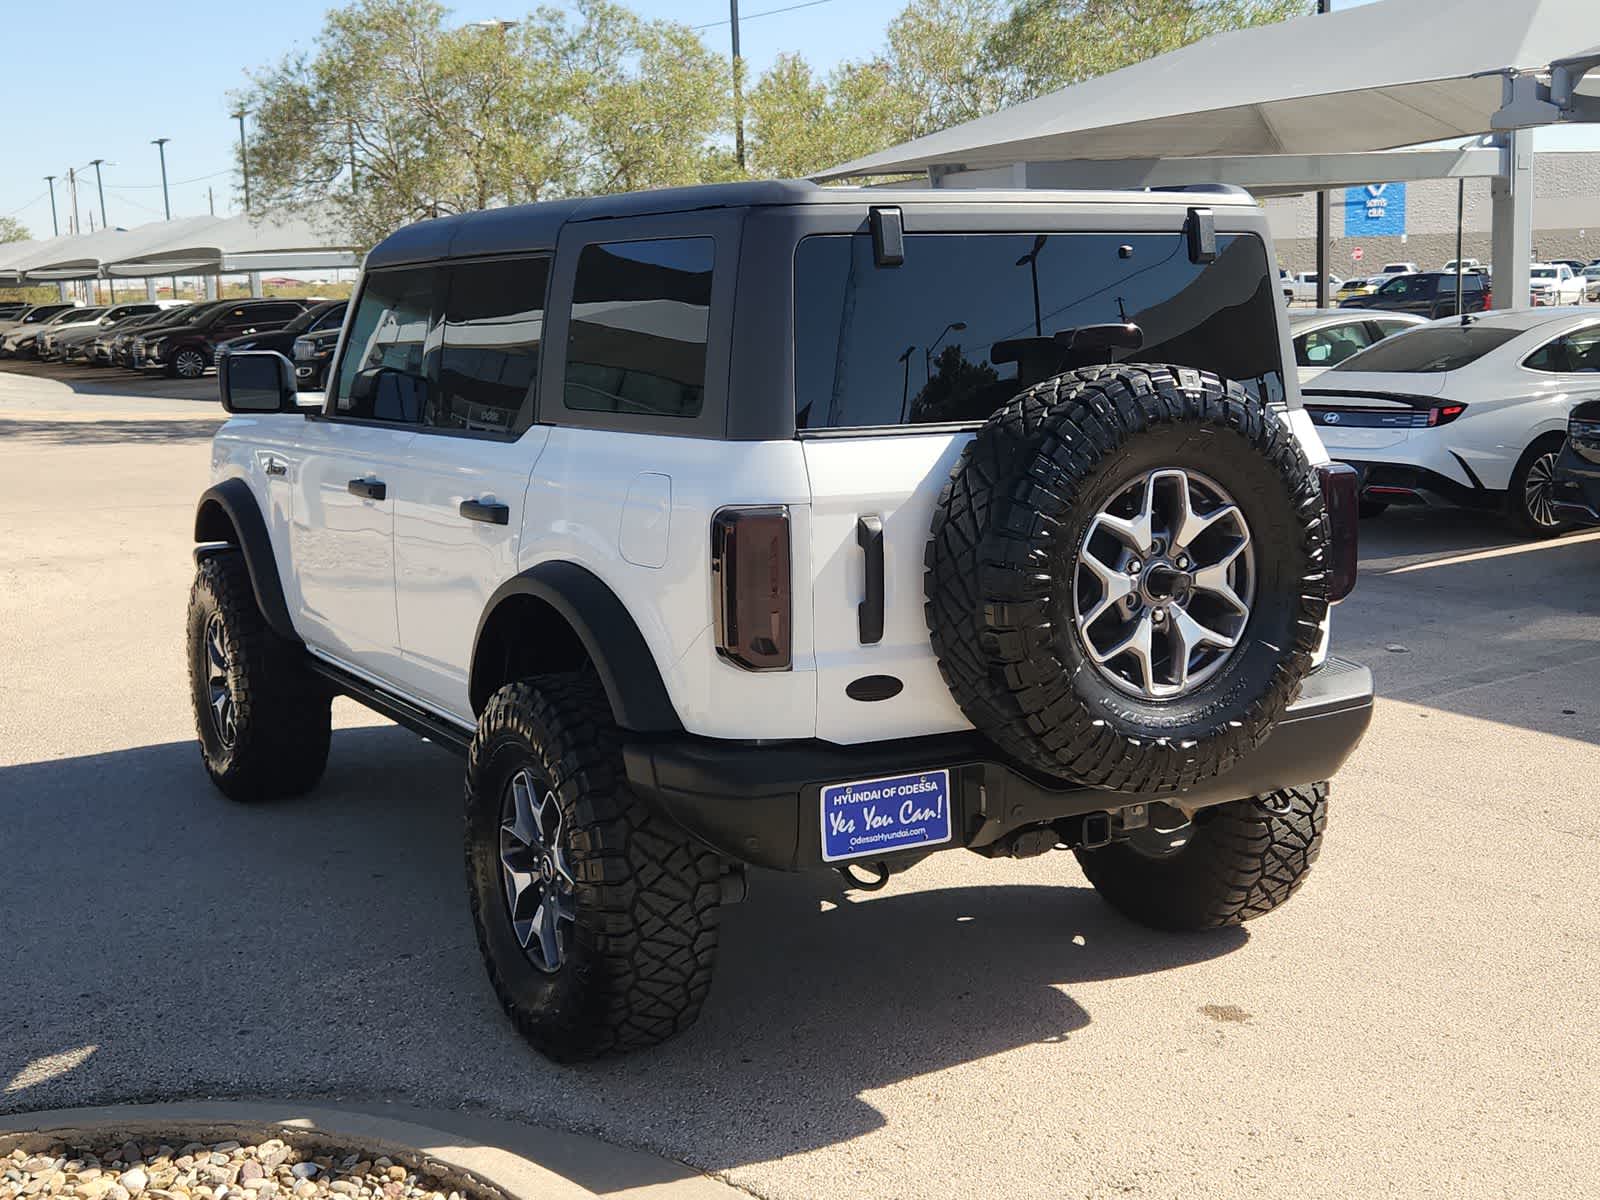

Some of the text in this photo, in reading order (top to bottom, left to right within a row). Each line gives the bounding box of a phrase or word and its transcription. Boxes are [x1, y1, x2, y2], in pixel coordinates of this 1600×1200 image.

[834, 782, 938, 806] HYUNDAI OF ODESSA
[829, 794, 942, 836] Yes You Can!
[850, 827, 926, 846] OdessaHyundai.com
